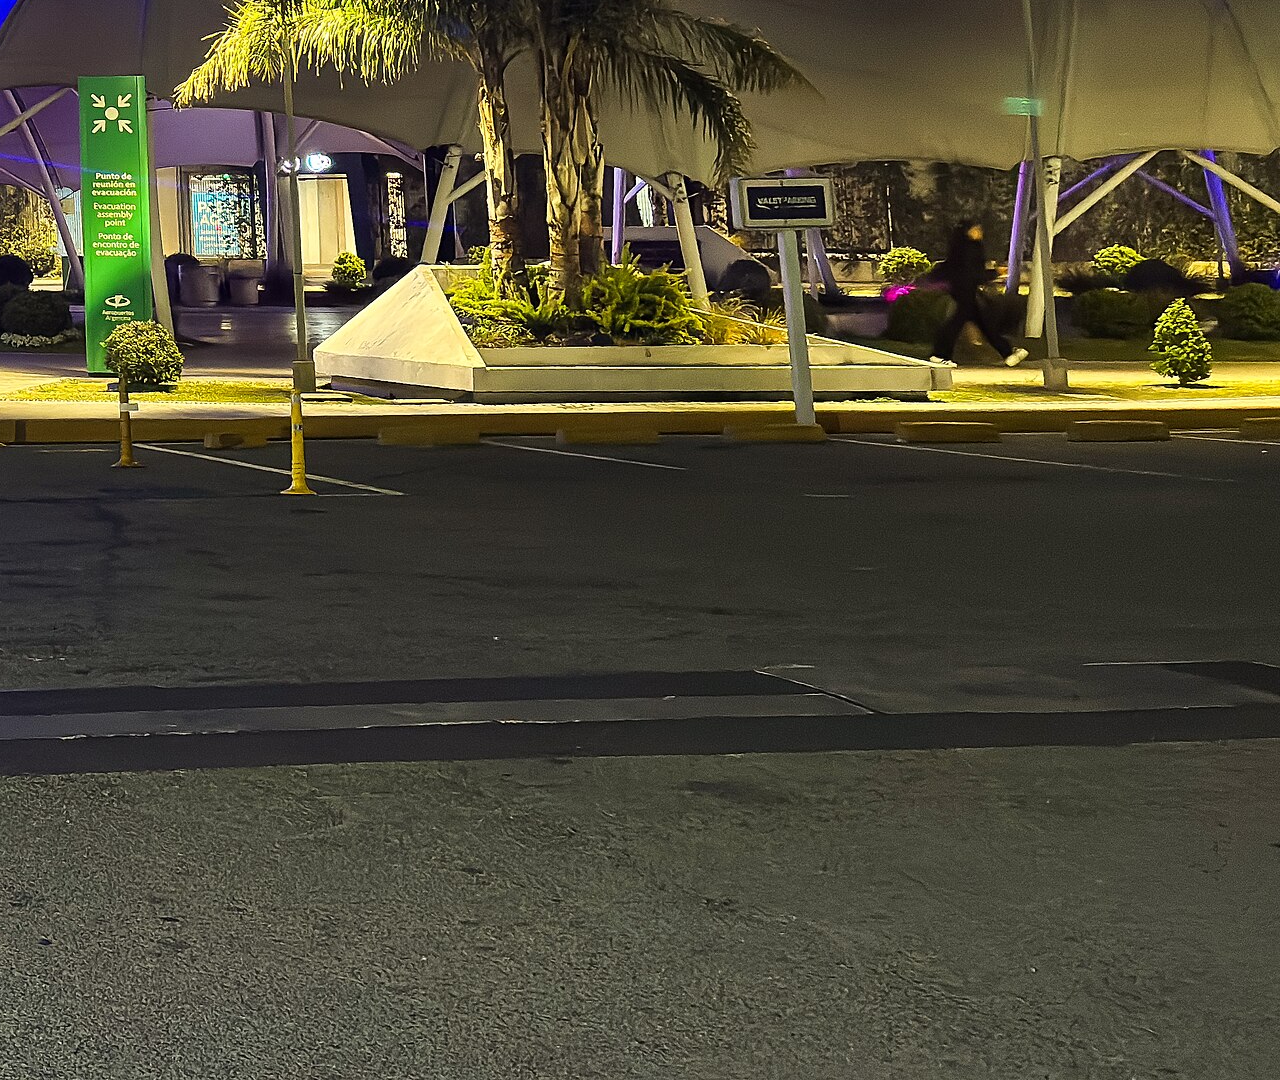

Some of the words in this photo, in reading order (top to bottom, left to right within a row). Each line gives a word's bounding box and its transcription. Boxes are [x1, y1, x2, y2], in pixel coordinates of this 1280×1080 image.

[95, 172, 120, 180] Punto
[121, 172, 132, 180] de
[91, 188, 137, 196] evacuación
[93, 202, 136, 210] Evacuation
[96, 211, 133, 220] assembly
[104, 219, 126, 227] point
[98, 232, 121, 240] Ponto
[122, 232, 133, 240] de
[129, 241, 140, 249] de
[95, 249, 137, 258] evacuação
